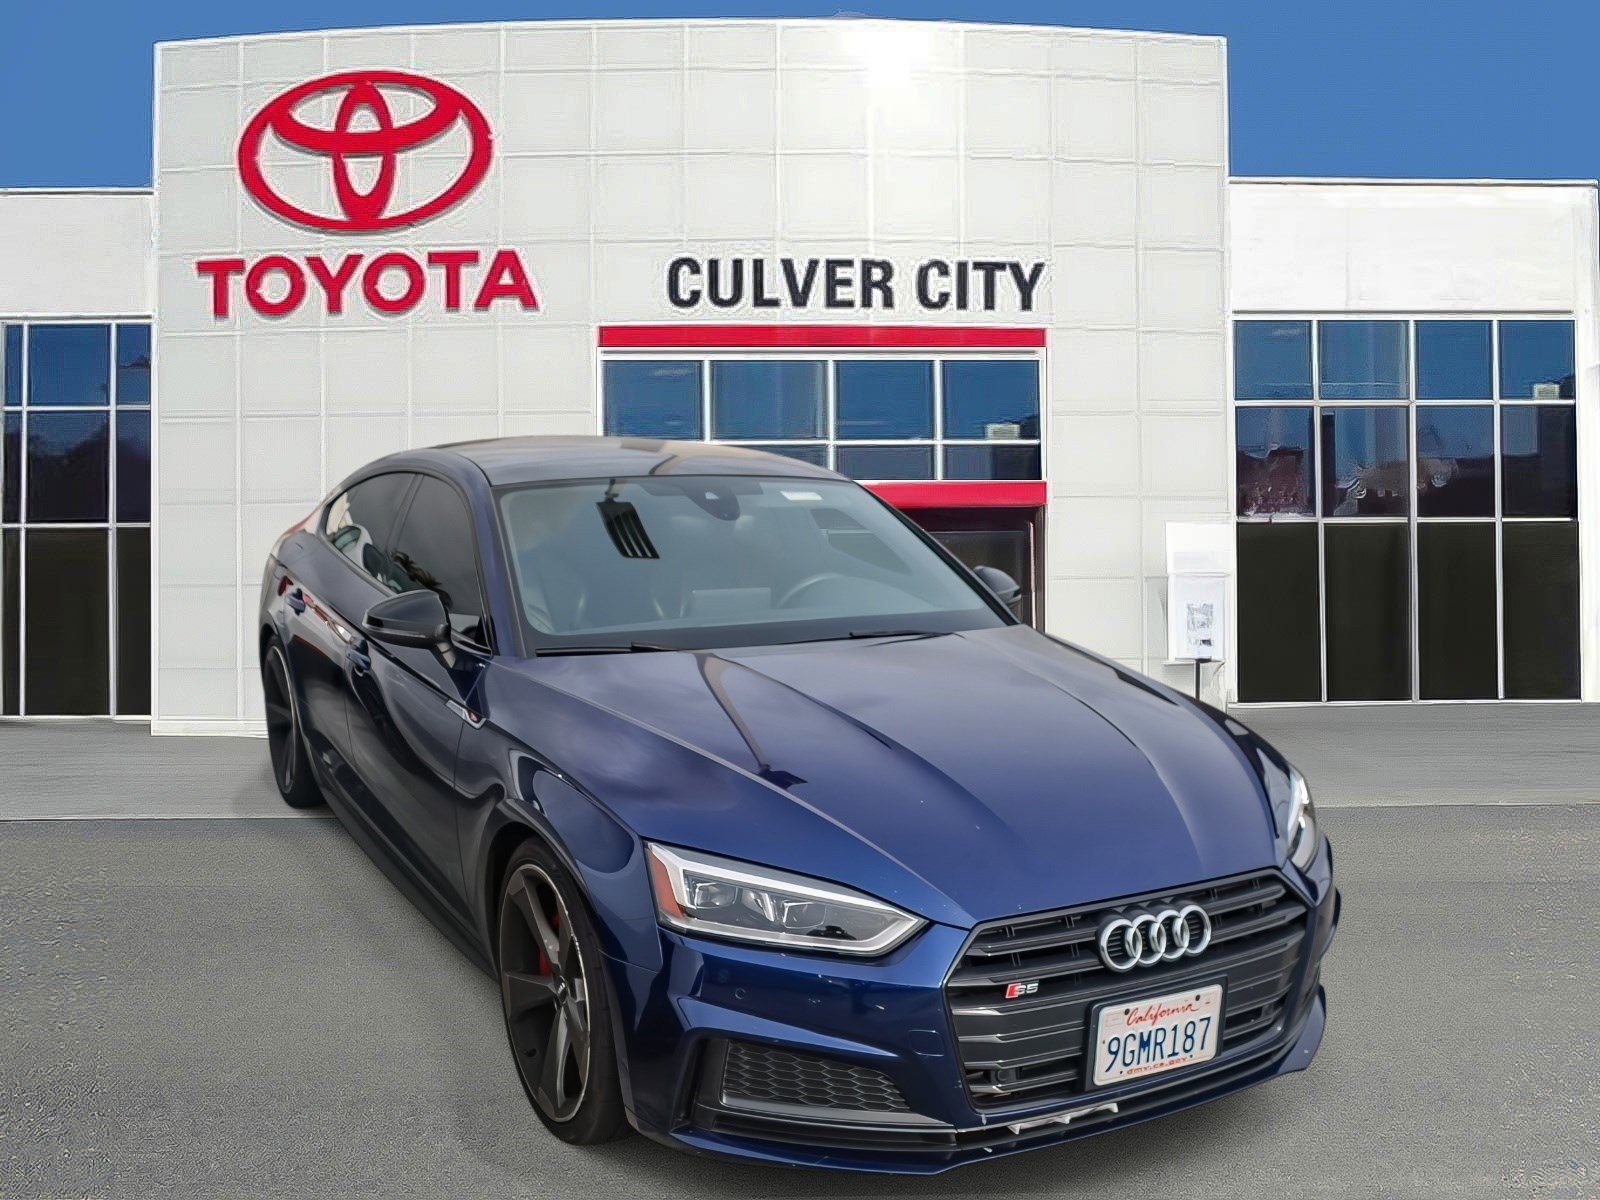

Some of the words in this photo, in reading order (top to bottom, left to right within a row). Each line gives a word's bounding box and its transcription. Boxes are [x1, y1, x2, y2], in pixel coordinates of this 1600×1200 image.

[196, 250, 538, 317] TOYOTA
[668, 257, 894, 309] CULVER
[916, 260, 1044, 311] CITY
[1126, 1004, 1200, 1026] California
[1105, 1016, 1211, 1073] 9GMR187
